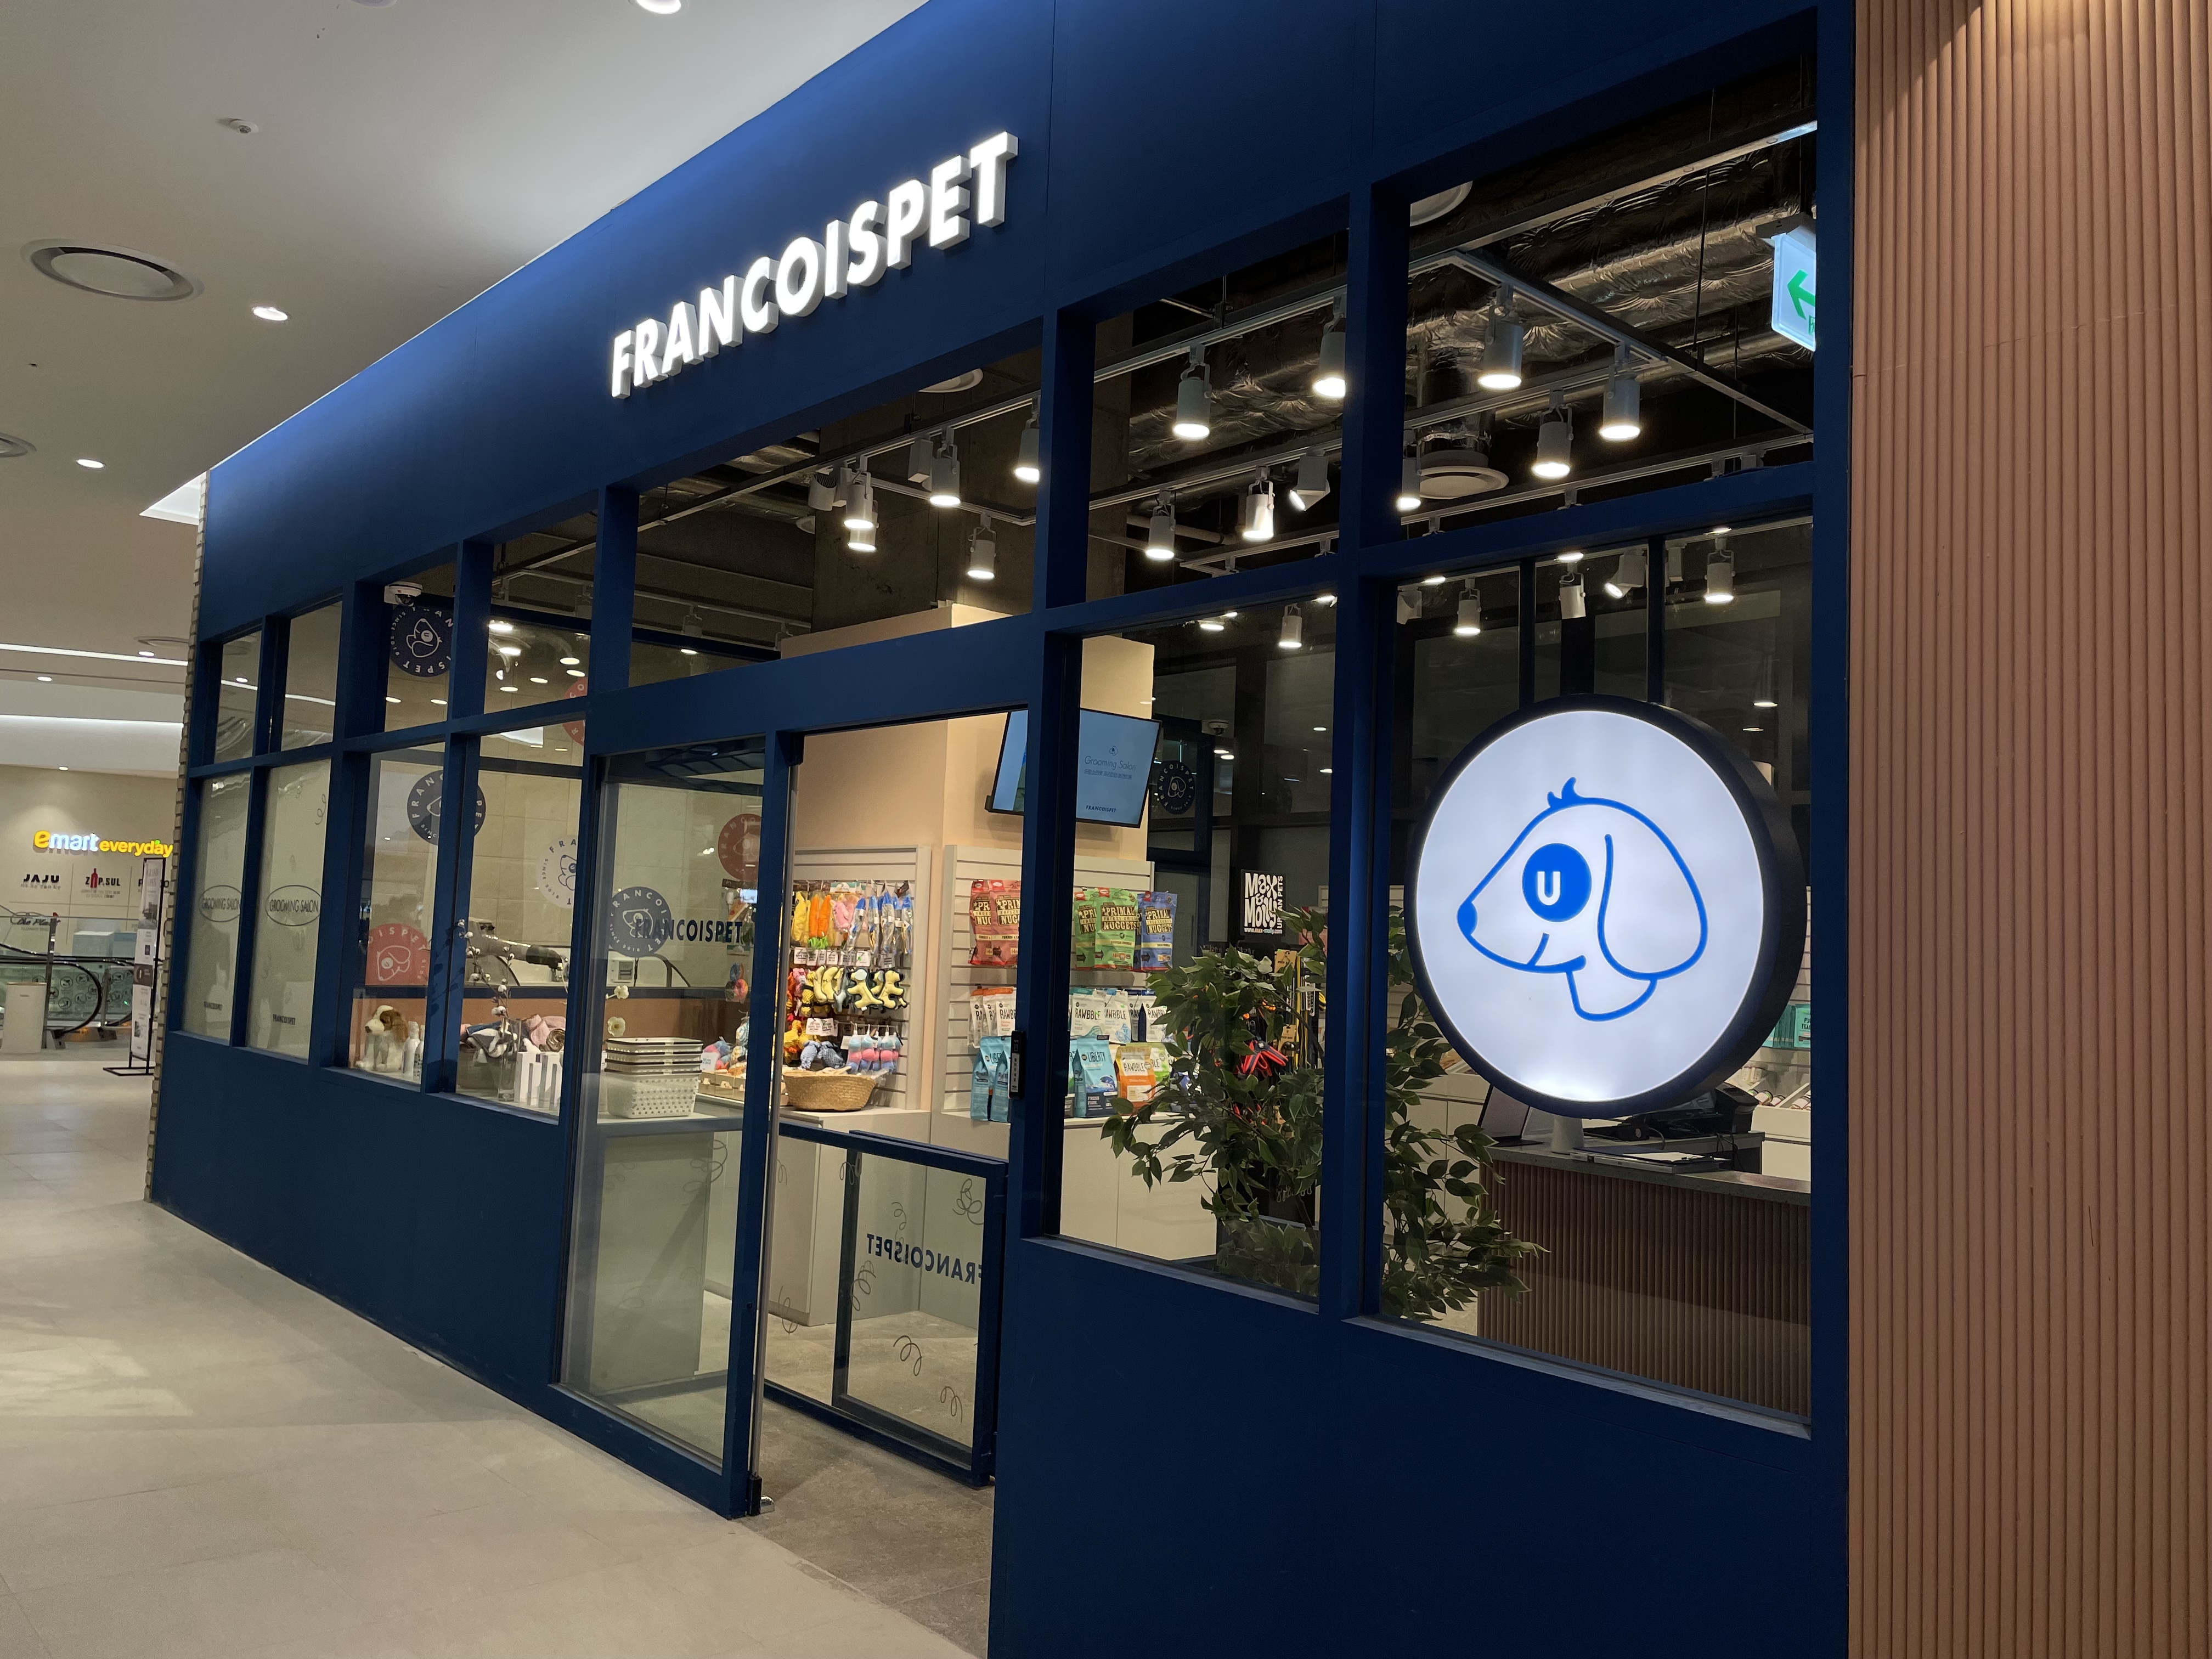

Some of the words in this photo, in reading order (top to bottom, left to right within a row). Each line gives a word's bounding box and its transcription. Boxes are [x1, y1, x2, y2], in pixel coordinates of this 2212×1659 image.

[611, 132, 1018, 399] FRANCOISPET
[1085, 755, 1117, 770] Grooming
[1119, 760, 1136, 771] Salon
[34, 831, 99, 851] emart
[99, 840, 173, 857] everyday
[23, 874, 59, 883] JAJU
[1537, 871, 1561, 905] U
[269, 899, 299, 912] GROOMING
[301, 900, 318, 913] SALON
[1106, 906, 1135, 916] PRIMAL
[1147, 910, 1170, 919] PRIMAL
[635, 919, 742, 943] FRANCOISPET
[1104, 921, 1137, 930] NUGGETS
[1075, 1008, 1101, 1020] RAWBBLE
[1105, 1009, 1126, 1019] AWBBLE
[1087, 1052, 1106, 1062] LIBERTY
[1124, 1063, 1145, 1071] RAWBBLE
